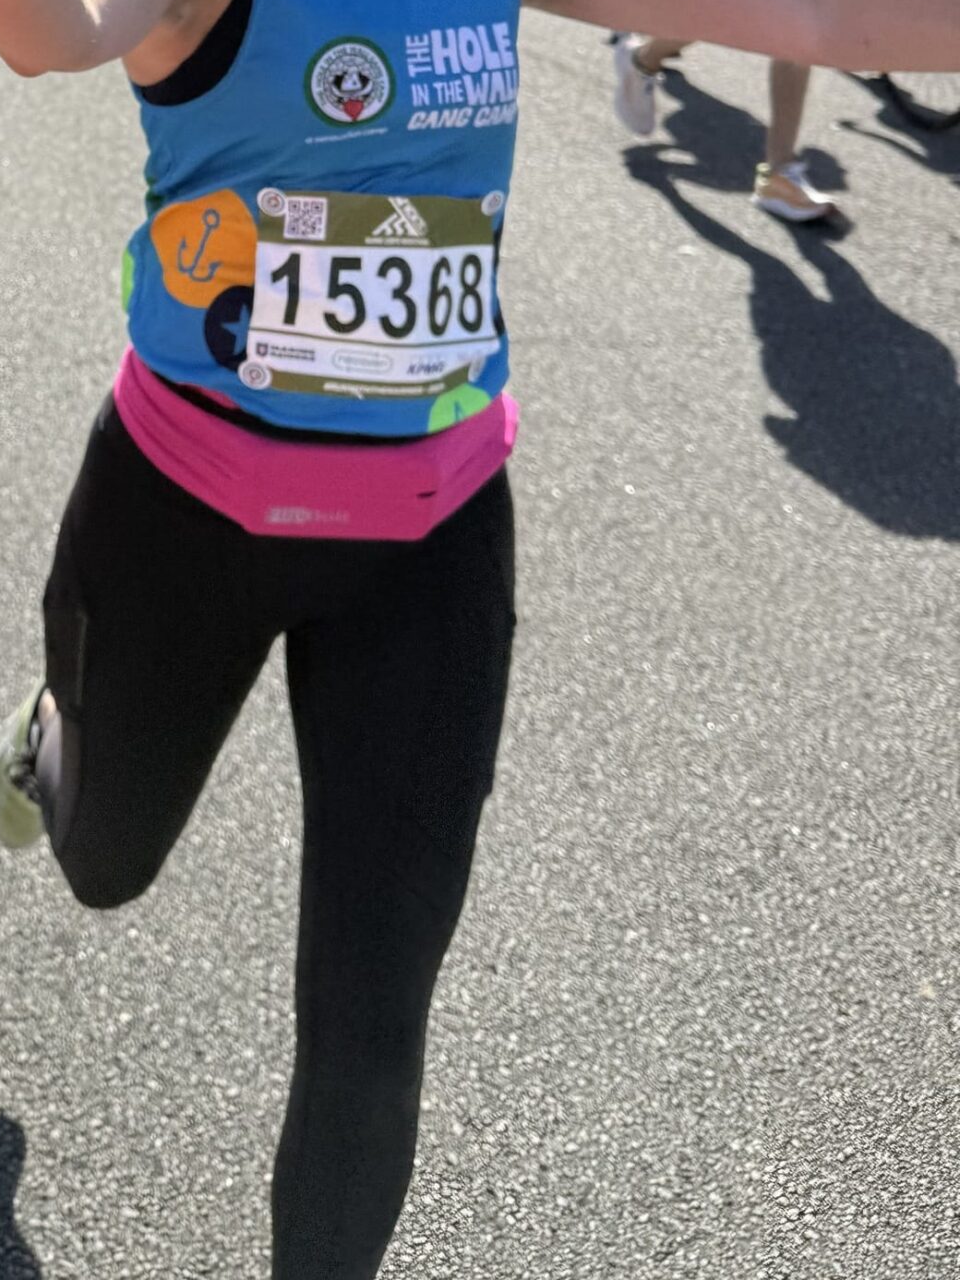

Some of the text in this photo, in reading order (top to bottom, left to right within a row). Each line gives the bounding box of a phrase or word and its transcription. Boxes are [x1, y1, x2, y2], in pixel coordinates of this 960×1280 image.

[406, 34, 431, 78] THE
[431, 23, 514, 75] HOLE
[411, 83, 430, 107] IN
[433, 79, 464, 104] THE
[407, 108, 472, 130] GANG
[271, 252, 483, 338] 15368
